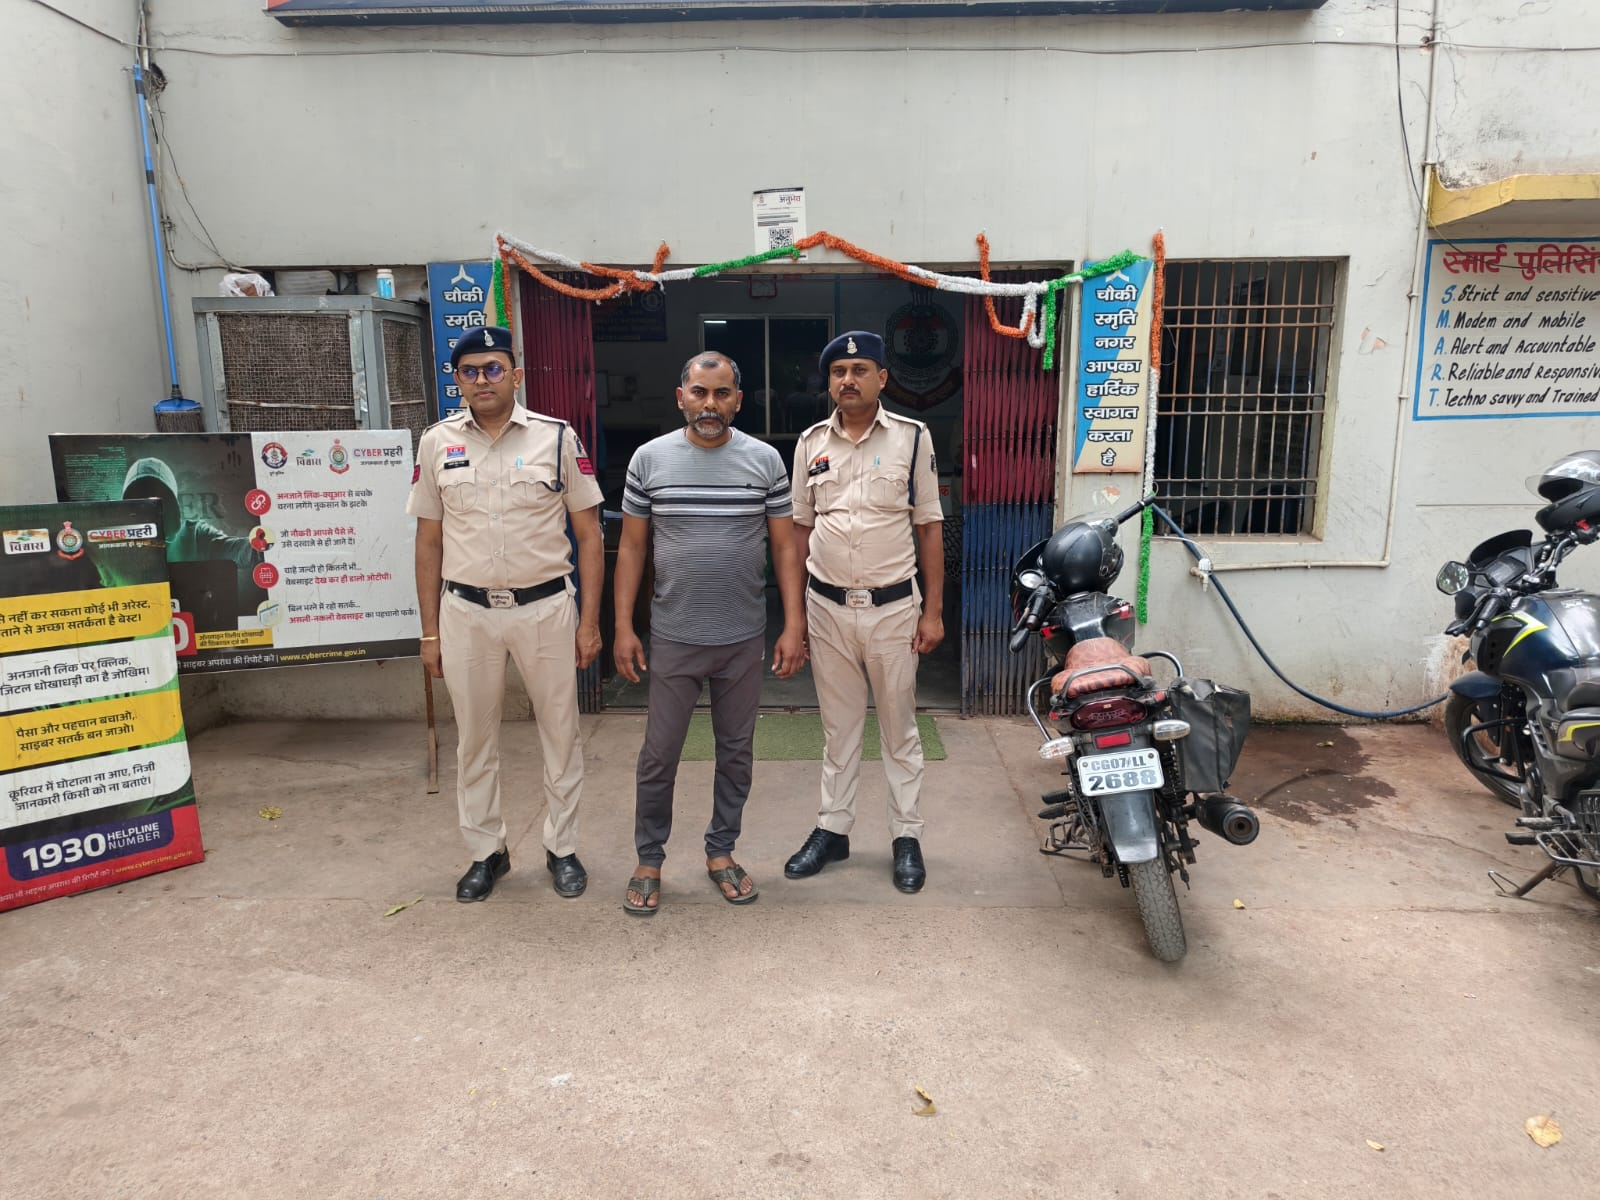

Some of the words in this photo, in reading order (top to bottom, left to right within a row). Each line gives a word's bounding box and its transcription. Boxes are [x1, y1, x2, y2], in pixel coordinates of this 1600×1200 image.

[1443, 244, 1508, 274] स्मार्ट
[1514, 244, 1600, 281] पुलिसिं
[444, 287, 484, 303] चौकी
[1096, 285, 1137, 302] चौकी
[1457, 284, 1500, 302] Strict
[1505, 286, 1533, 302] and
[1536, 285, 1600, 302] sensitive
[445, 310, 487, 331] स्मृति
[1095, 309, 1138, 330] स्मृति
[1503, 312, 1533, 328] and
[1095, 336, 1135, 350] नगर
[1451, 336, 1485, 355] Alert
[1485, 336, 1512, 355] and
[1515, 335, 1596, 354] Accountable
[1086, 359, 1141, 374] आपका
[1448, 362, 1505, 381] Reliable
[1505, 362, 1535, 380] and
[1086, 379, 1138, 397] हार्दिक
[1445, 388, 1487, 407] Techno
[1526, 387, 1551, 404] and
[1552, 387, 1600, 404] Trained
[1084, 406, 1138, 421] स्वागत
[1087, 429, 1133, 443] करता
[353, 448, 382, 457] CYBER
[382, 445, 403, 457] प्रहरी
[1101, 448, 1117, 467] है
[89, 529, 126, 541] CYBER
[127, 525, 153, 538] प्रहरी
[8, 611, 28, 623] नहीं
[30, 611, 48, 620] कर
[50, 607, 82, 619] सकता
[84, 603, 106, 615] कोई
[107, 600, 119, 612] भी
[121, 599, 151, 611] अरेस्ट,
[0, 626, 20, 638] ताने
[23, 625, 33, 635] से
[36, 622, 65, 634] अच्छा
[67, 617, 107, 630] सतर्कता
[108, 613, 116, 626] है
[118, 613, 142, 624] बेस्ट।
[280, 648, 366, 661] www.cybercrime.gov.in
[7, 665, 51, 681] अनजानी
[54, 661, 79, 675] लिंक
[81, 660, 95, 671] पर
[97, 656, 132, 669] क्लिक,
[0, 683, 31, 697] जिटल
[34, 676, 82, 691] धोखाधड़ी
[85, 673, 99, 684] का
[101, 670, 109, 682] है
[111, 666, 150, 681] जोखिम।
[16, 725, 38, 739] पैसा
[41, 722, 60, 735] और
[62, 718, 97, 731] पहचान
[99, 710, 135, 724] बचाओ,
[19, 738, 54, 752] साइबर
[56, 731, 84, 745] सतर्क
[87, 730, 103, 740] बन
[105, 724, 135, 737] जाओ।
[8, 785, 43, 802] कूरियर
[45, 780, 54, 792] में
[56, 775, 92, 789] घोटाला
[94, 772, 107, 782] ना
[108, 768, 131, 780] आए,
[132, 761, 156, 775] निजी
[1088, 769, 1158, 791] 2688
[15, 793, 60, 811] जानकारी
[63, 786, 90, 802] किसी
[92, 784, 107, 795] को
[108, 782, 120, 792] ना
[107, 822, 160, 841] HELPLINE
[108, 831, 160, 850] NUMBER
[22, 833, 107, 872] 1930
